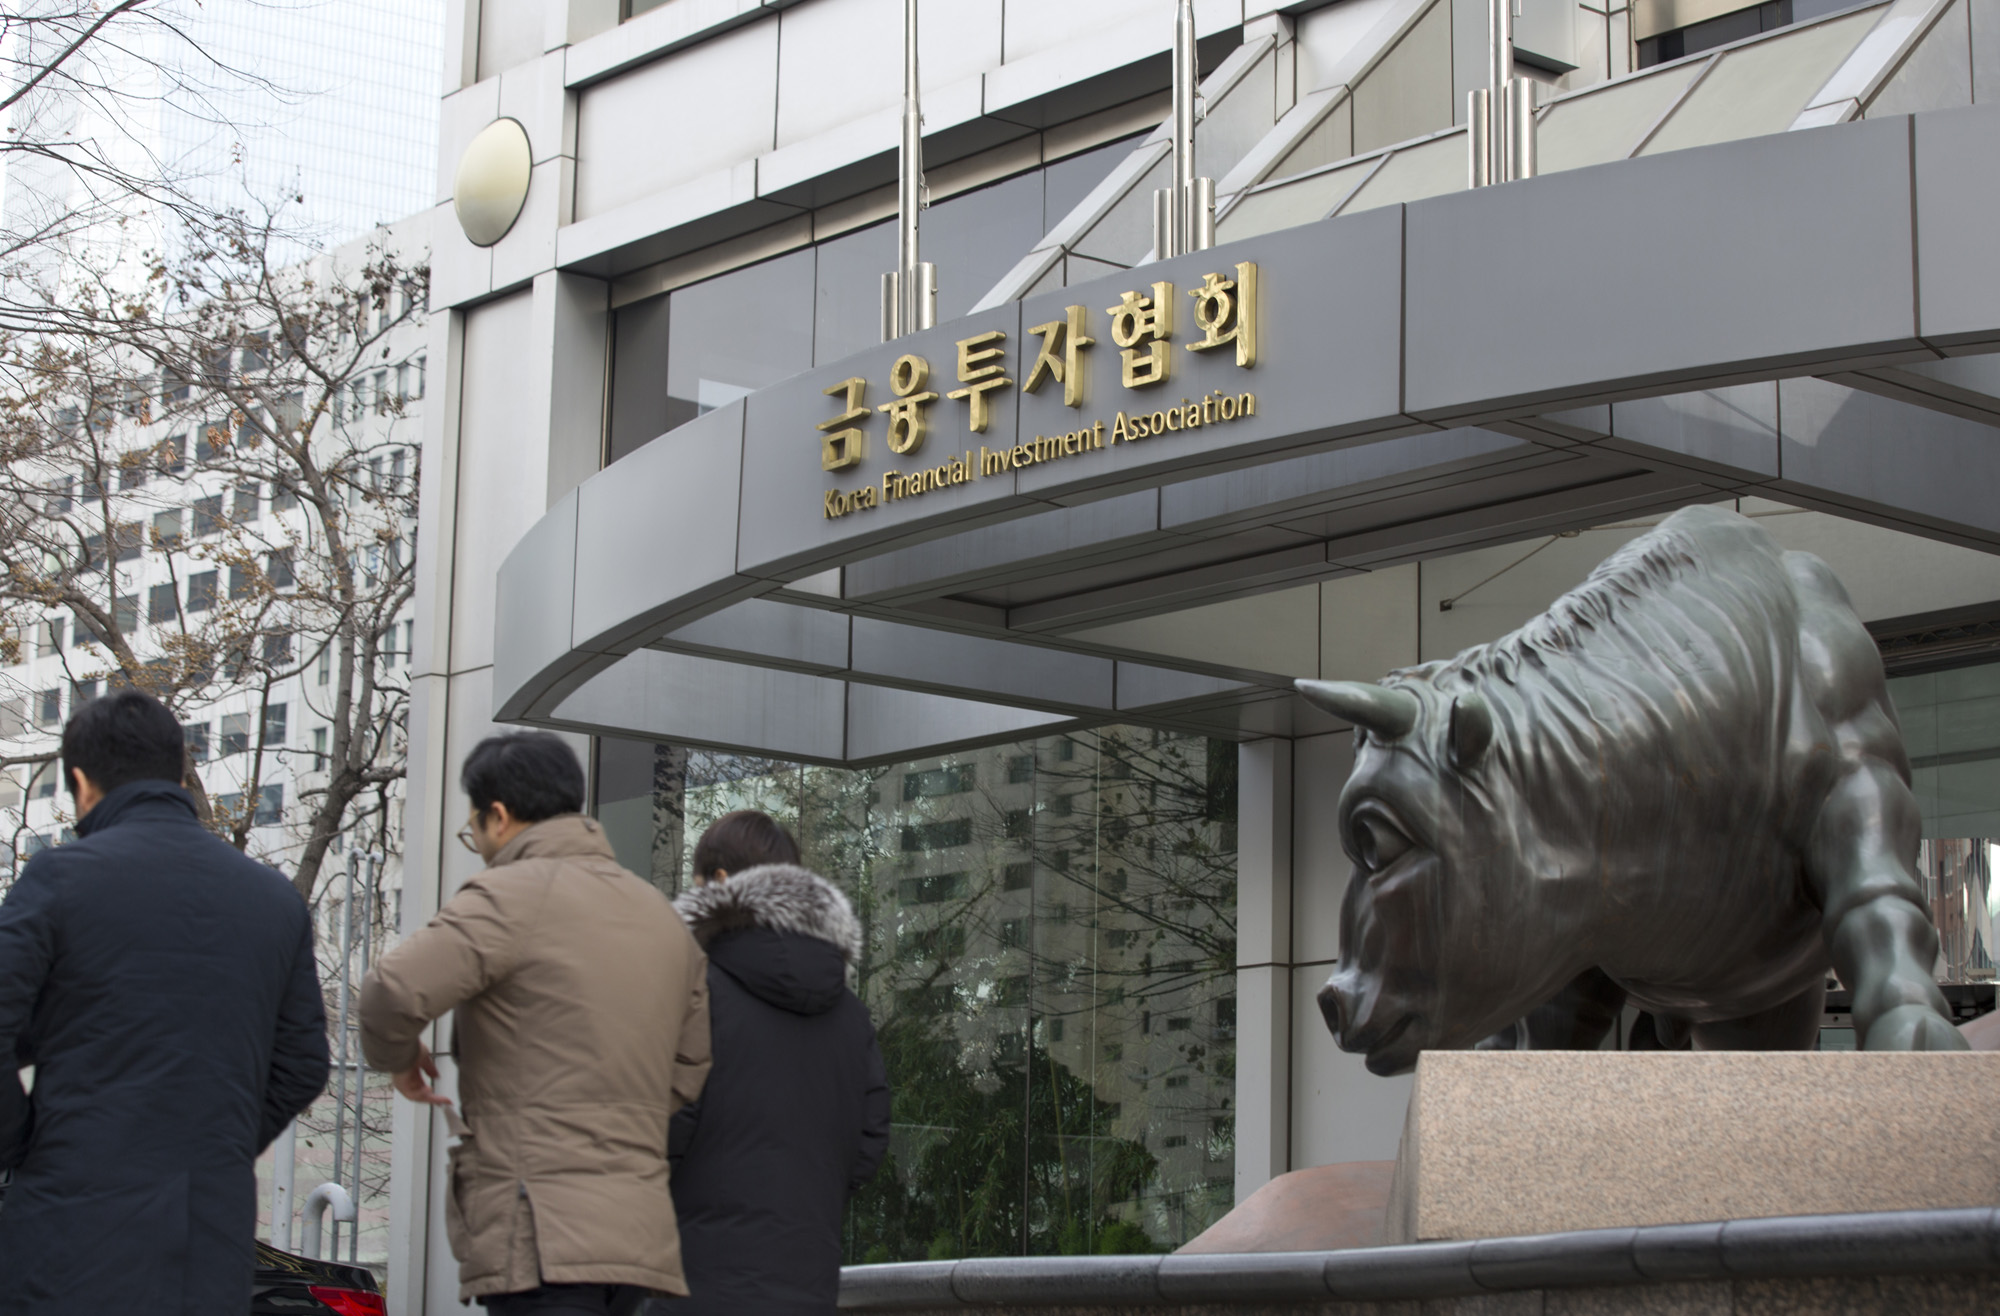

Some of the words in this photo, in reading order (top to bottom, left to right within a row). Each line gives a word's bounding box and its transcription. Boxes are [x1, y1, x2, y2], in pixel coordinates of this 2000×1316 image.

[816, 261, 1257, 472] 금융투자협회
[823, 486, 877, 519] Korea
[883, 451, 973, 502] Financial
[981, 421, 1105, 476] Investment
[1111, 391, 1255, 445] Association
